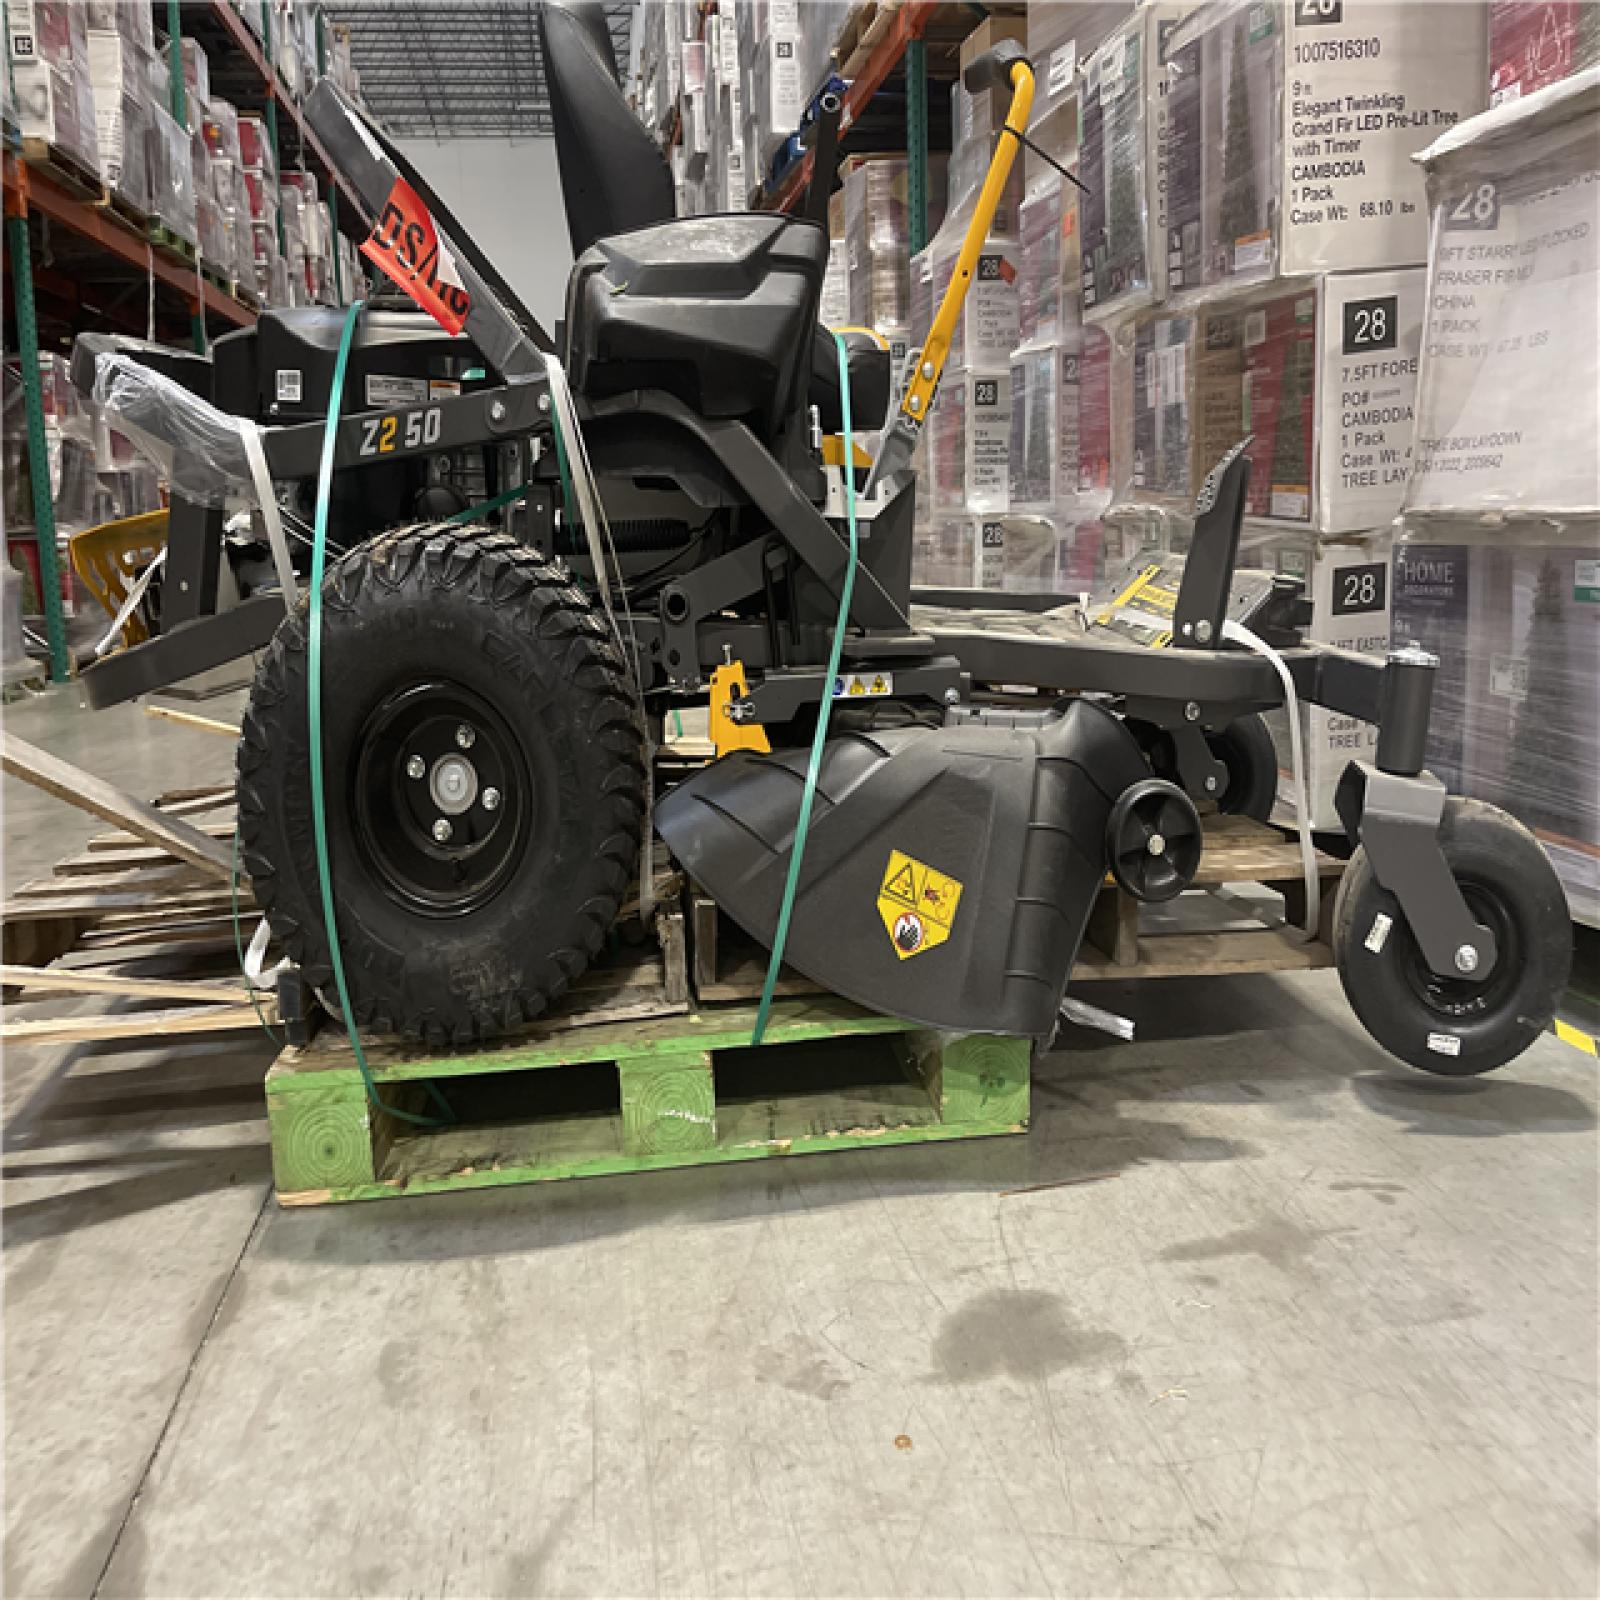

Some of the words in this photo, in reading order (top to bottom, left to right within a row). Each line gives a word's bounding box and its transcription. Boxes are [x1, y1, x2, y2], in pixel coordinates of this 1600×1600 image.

[1294, 37, 1381, 63] 1007516310
[1292, 98, 1342, 118] Elegant
[1345, 93, 1406, 113] Twinkling
[1292, 121, 1333, 138] Grand
[1336, 116, 1353, 133] Fir
[1357, 114, 1384, 131] LED
[1387, 110, 1428, 129] Pre-Lit
[1432, 109, 1459, 125] Tree
[1292, 139, 1321, 158] with
[1325, 138, 1362, 154] Timer
[1292, 159, 1366, 181] CAMBODIA
[1291, 187, 1298, 203] 1
[1302, 184, 1334, 202] Pack
[1450, 184, 1496, 222] 28
[1290, 209, 1324, 226] Case
[1359, 200, 1393, 219] 68.10
[1434, 294, 1475, 311] CHINA
[1354, 307, 1386, 343] 28
[1342, 364, 1378, 382] 7.5FT
[1341, 406, 1415, 429] CAMBODIA
[359, 416, 398, 456] Z2
[404, 407, 441, 448] 50
[1341, 433, 1348, 448] 1
[1354, 430, 1386, 447] Pack
[1341, 452, 1373, 469] Case
[1341, 469, 1378, 489] TREE
[1404, 560, 1455, 584] HOME
[1344, 574, 1376, 606] 28
[1327, 716, 1358, 732] Case
[1327, 732, 1361, 750] TREE
